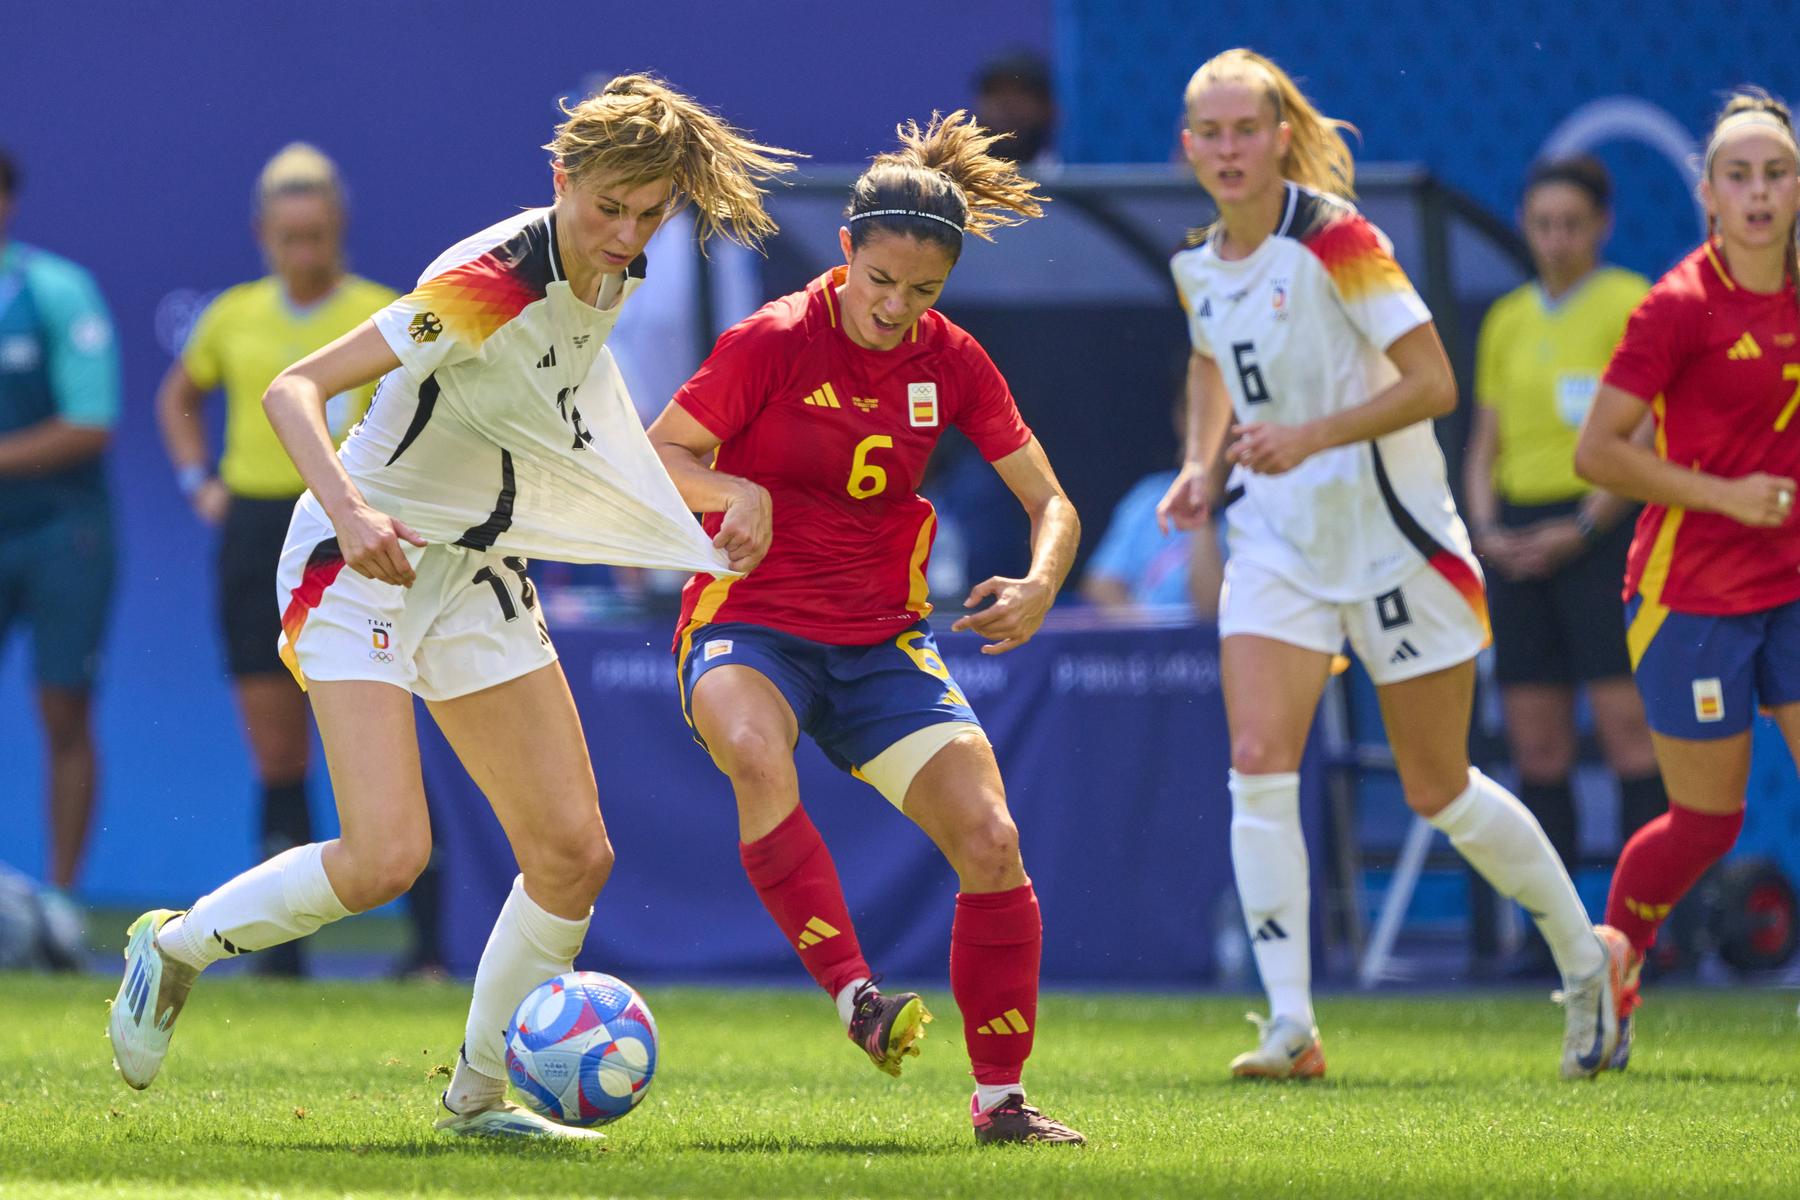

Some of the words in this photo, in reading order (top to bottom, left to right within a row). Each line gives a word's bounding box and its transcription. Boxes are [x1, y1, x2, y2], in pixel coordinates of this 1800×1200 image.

[1231, 341, 1272, 405] 6
[846, 434, 893, 499] 6
[368, 619, 392, 628] TEAM
[372, 628, 389, 649] D
[896, 631, 950, 681] 6
